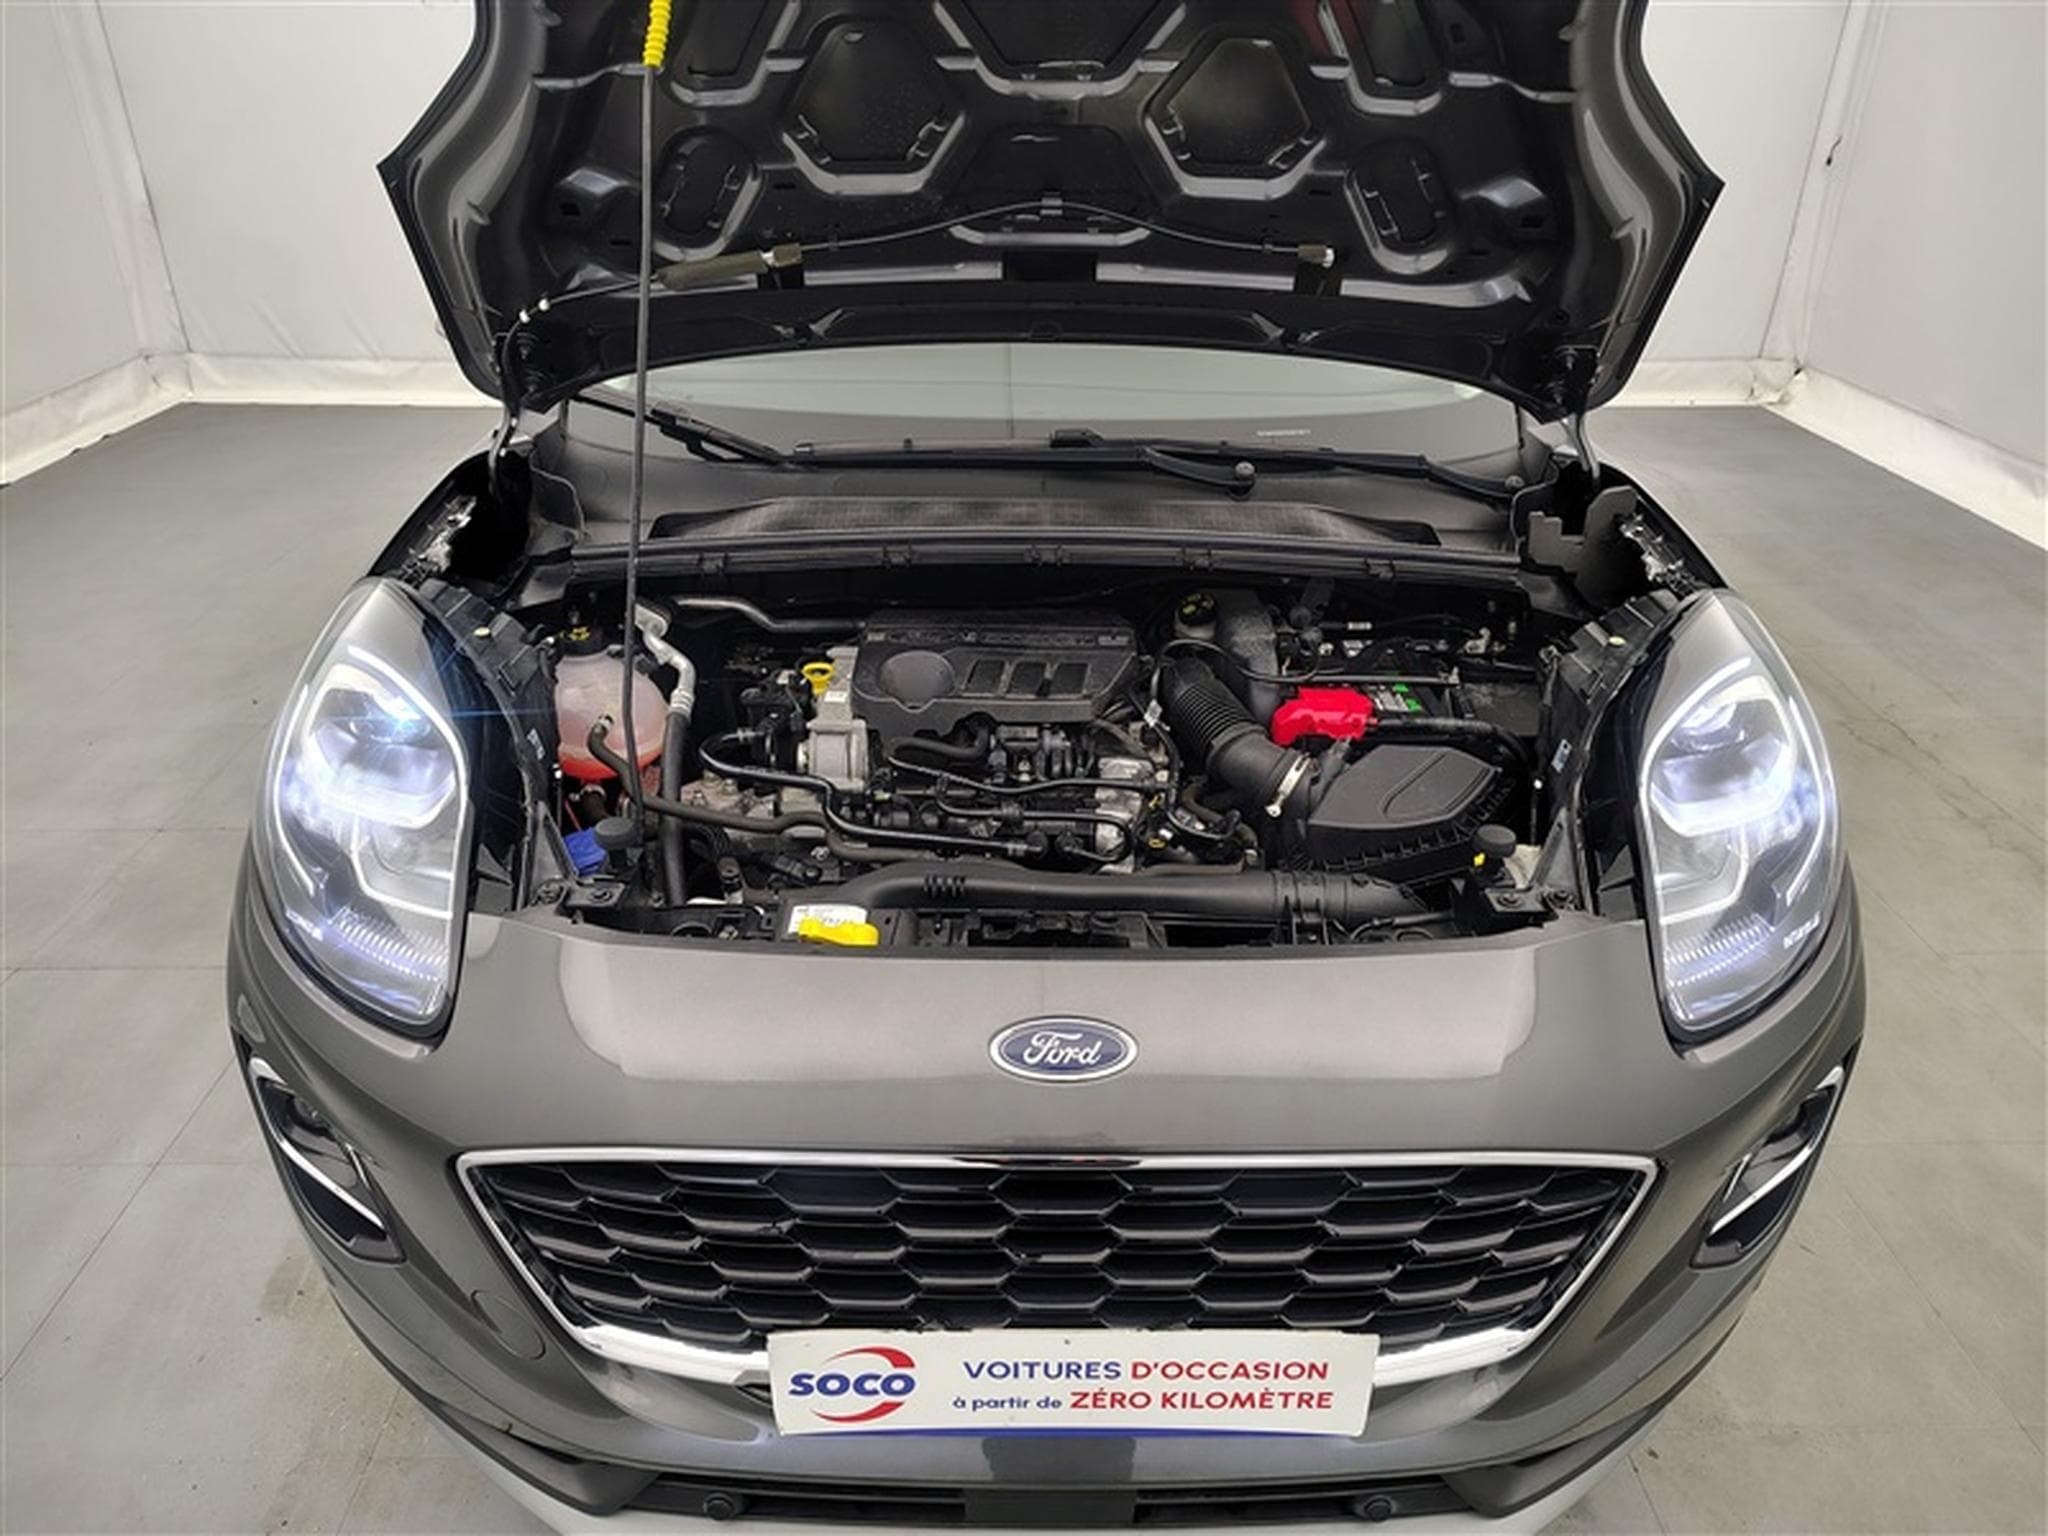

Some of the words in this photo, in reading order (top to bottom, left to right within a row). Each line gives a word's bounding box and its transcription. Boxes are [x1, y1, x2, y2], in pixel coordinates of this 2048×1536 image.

[1023, 1031, 1102, 1065] Ford
[963, 1361, 1121, 1380] VOITURES
[1131, 1361, 1329, 1380] D'OCCASION
[788, 1373, 916, 1396] SOCO
[952, 1395, 966, 1409] à
[972, 1395, 1031, 1412] partir
[1036, 1395, 1063, 1409] de
[1070, 1387, 1153, 1409] ZÉRO
[1161, 1387, 1334, 1409] KILOMÈTRE
